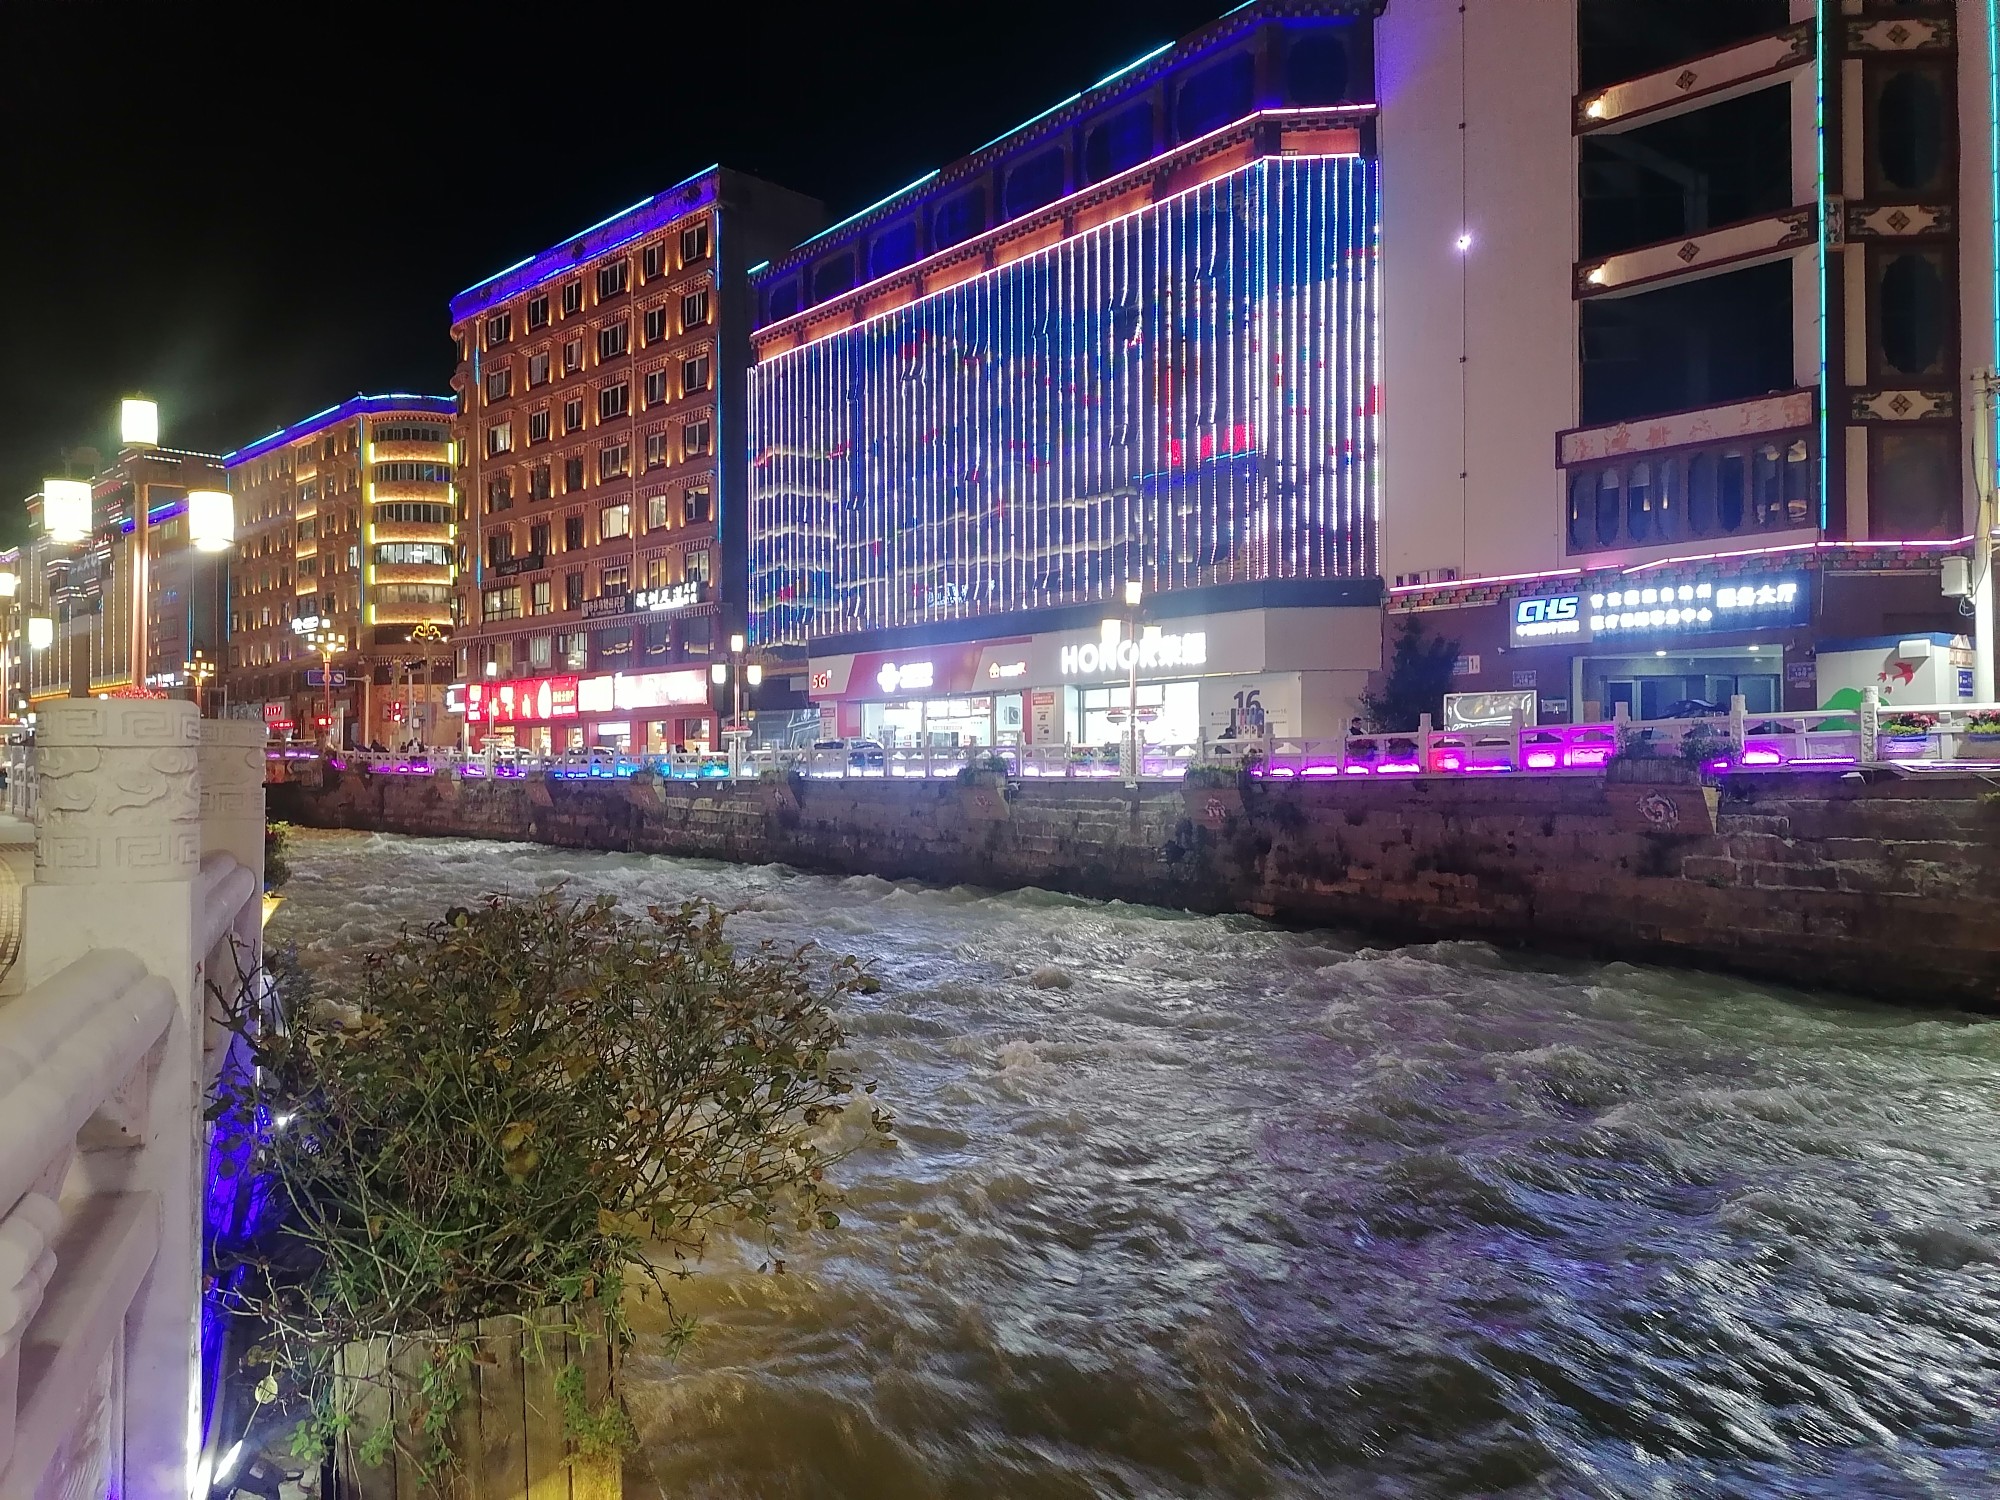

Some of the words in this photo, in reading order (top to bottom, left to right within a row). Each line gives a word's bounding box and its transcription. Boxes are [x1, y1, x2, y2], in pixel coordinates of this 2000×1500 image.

[1517, 597, 1579, 623] CHS
[1061, 639, 1159, 675] HONOR
[1233, 689, 1262, 709] 16
